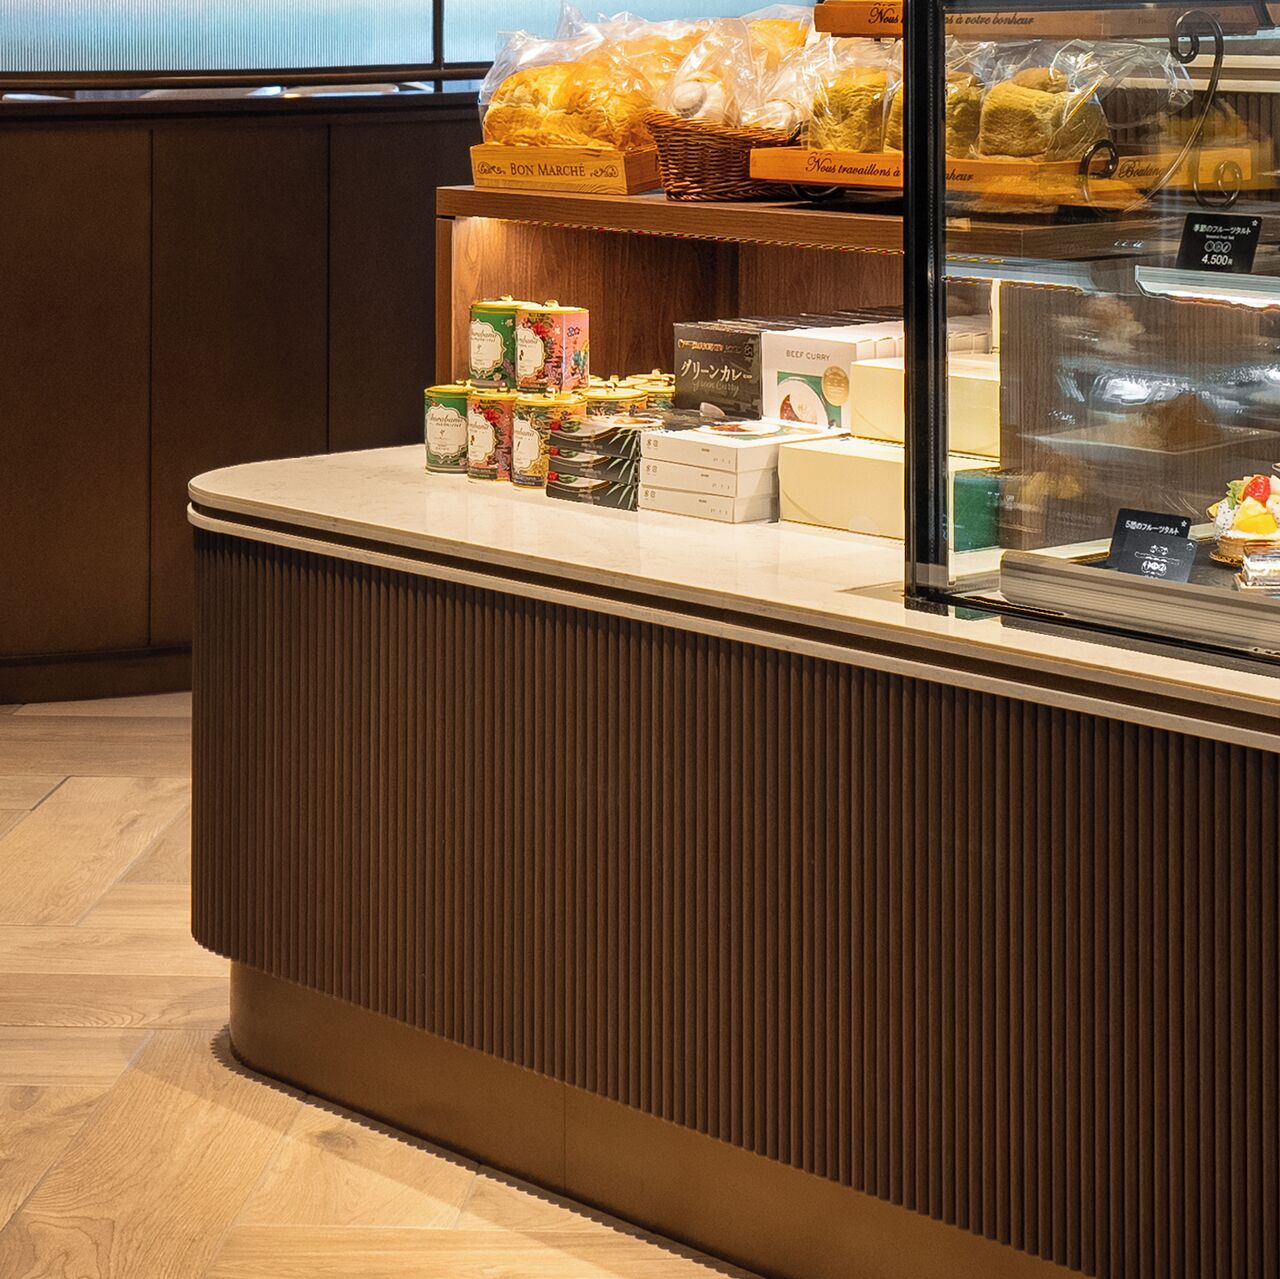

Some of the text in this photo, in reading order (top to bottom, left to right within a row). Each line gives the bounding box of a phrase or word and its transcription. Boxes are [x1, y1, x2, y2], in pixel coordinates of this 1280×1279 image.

[868, 6, 900, 24] Nous
[965, 15, 991, 24] votre
[992, 12, 1034, 24] bonheur
[510, 162, 586, 177] BON MARCHÉ
[805, 155, 836, 172] Nous
[838, 163, 891, 177] travaillons
[893, 166, 901, 177] à
[786, 349, 831, 361] BEEF CURRY
[680, 358, 753, 382] グリーンカレー
